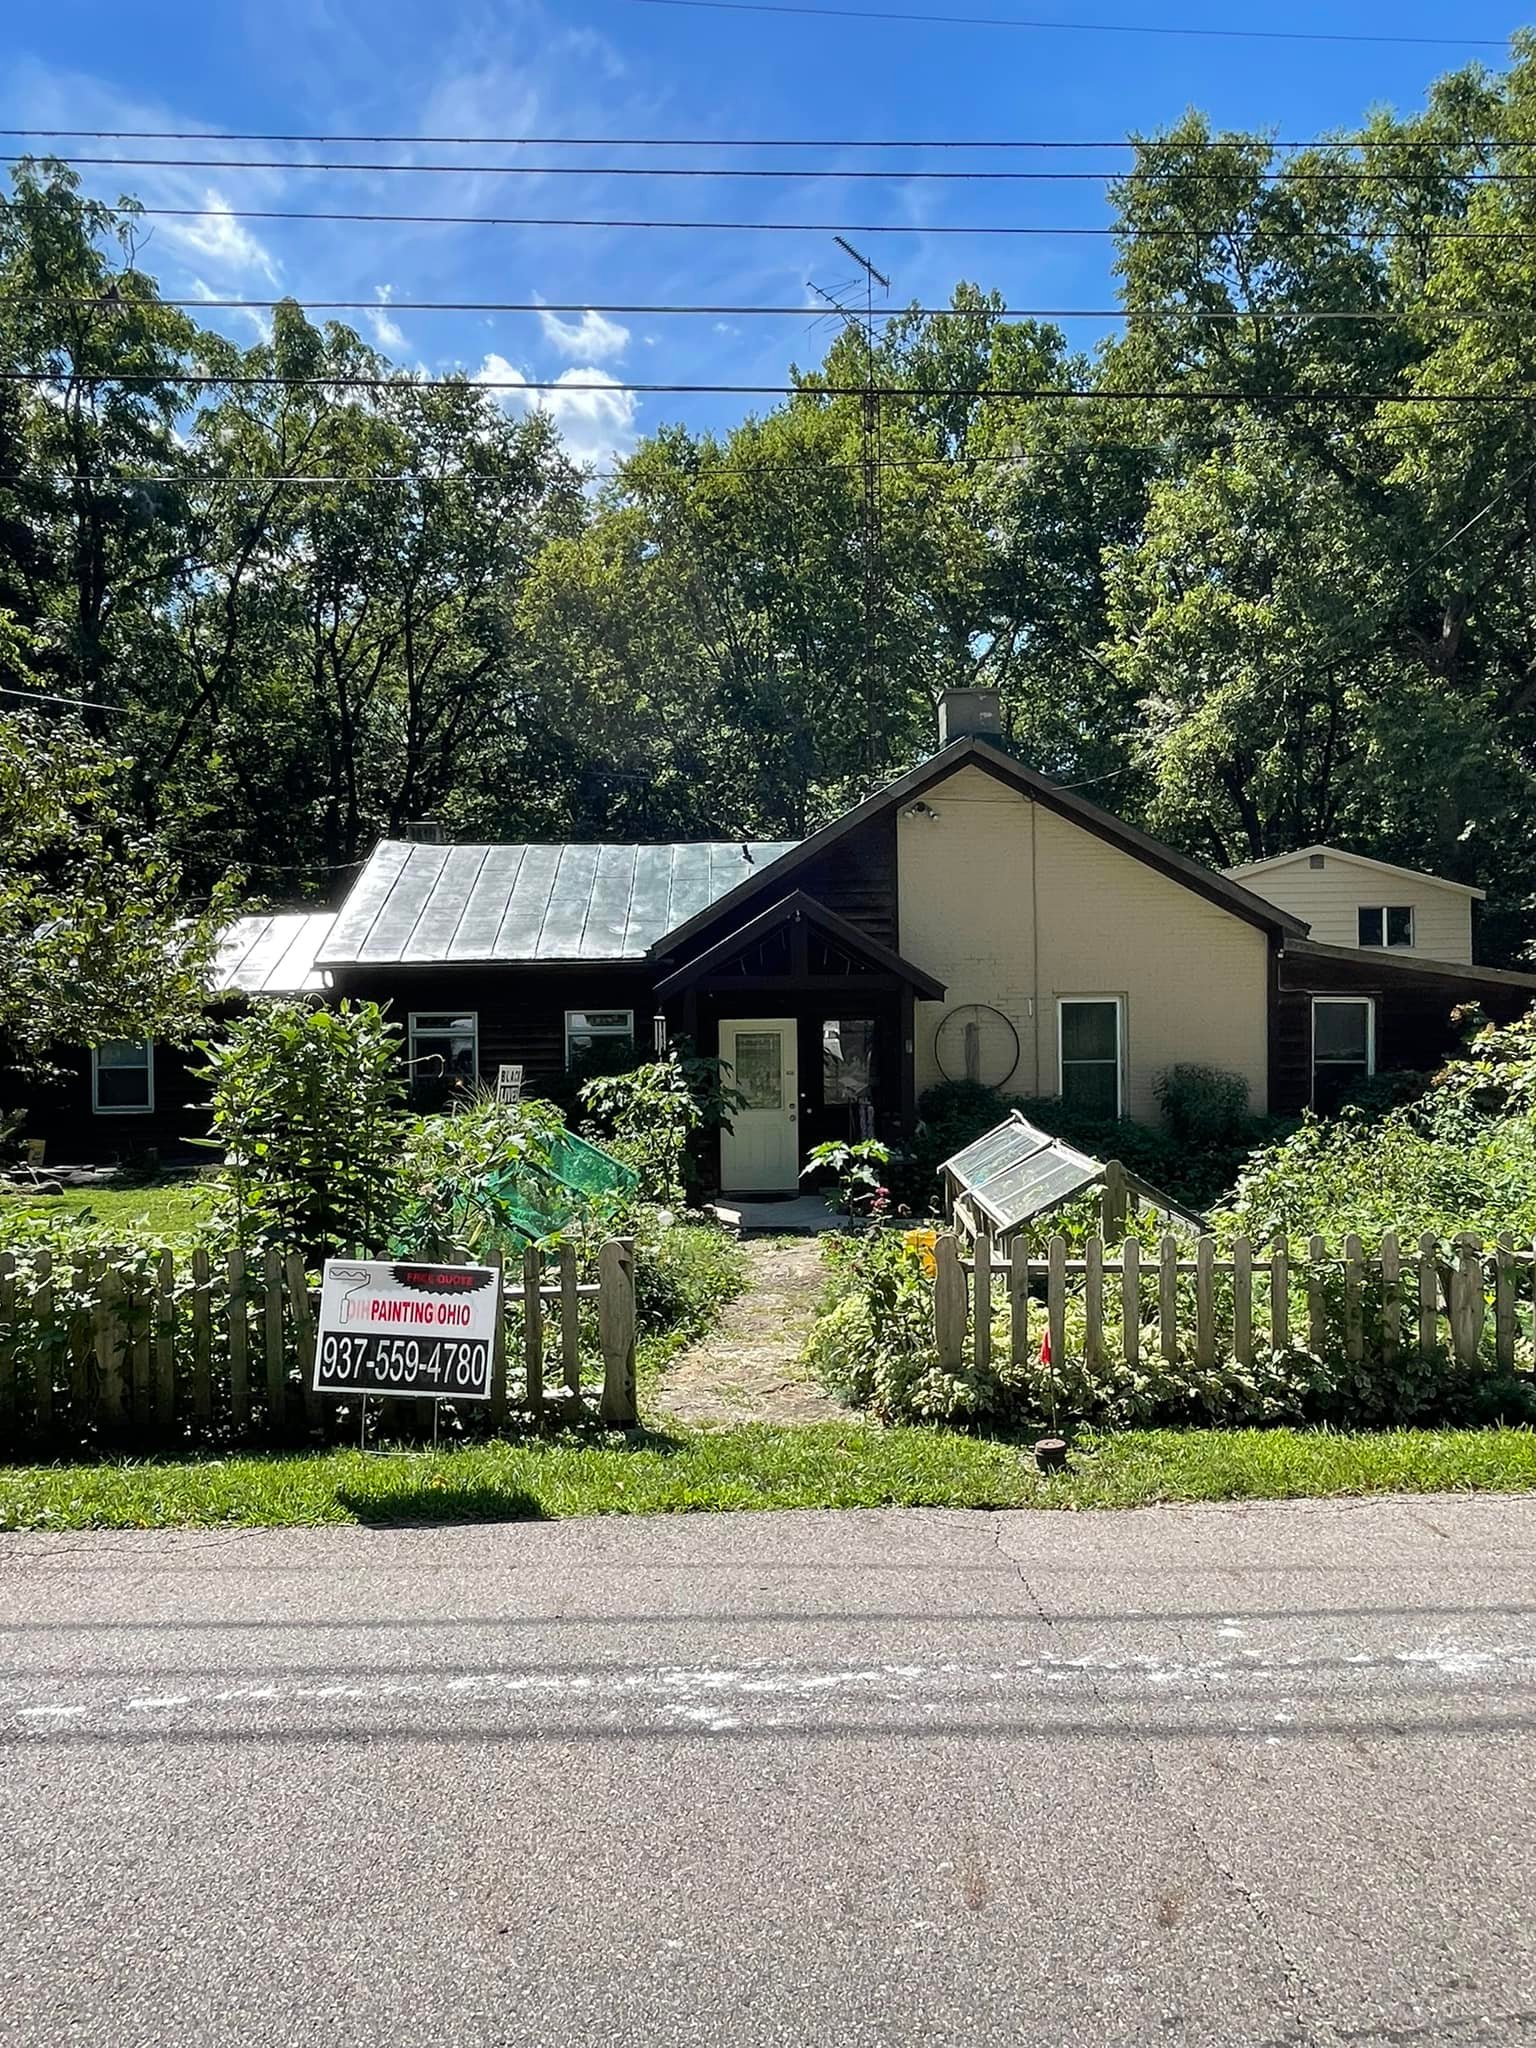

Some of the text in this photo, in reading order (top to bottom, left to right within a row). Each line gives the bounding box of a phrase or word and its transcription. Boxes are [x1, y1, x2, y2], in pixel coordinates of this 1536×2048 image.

[406, 1272, 474, 1286] FREE QUOTE
[437, 1303, 471, 1326] OHIO
[322, 1336, 486, 1386] 937-559-4780
